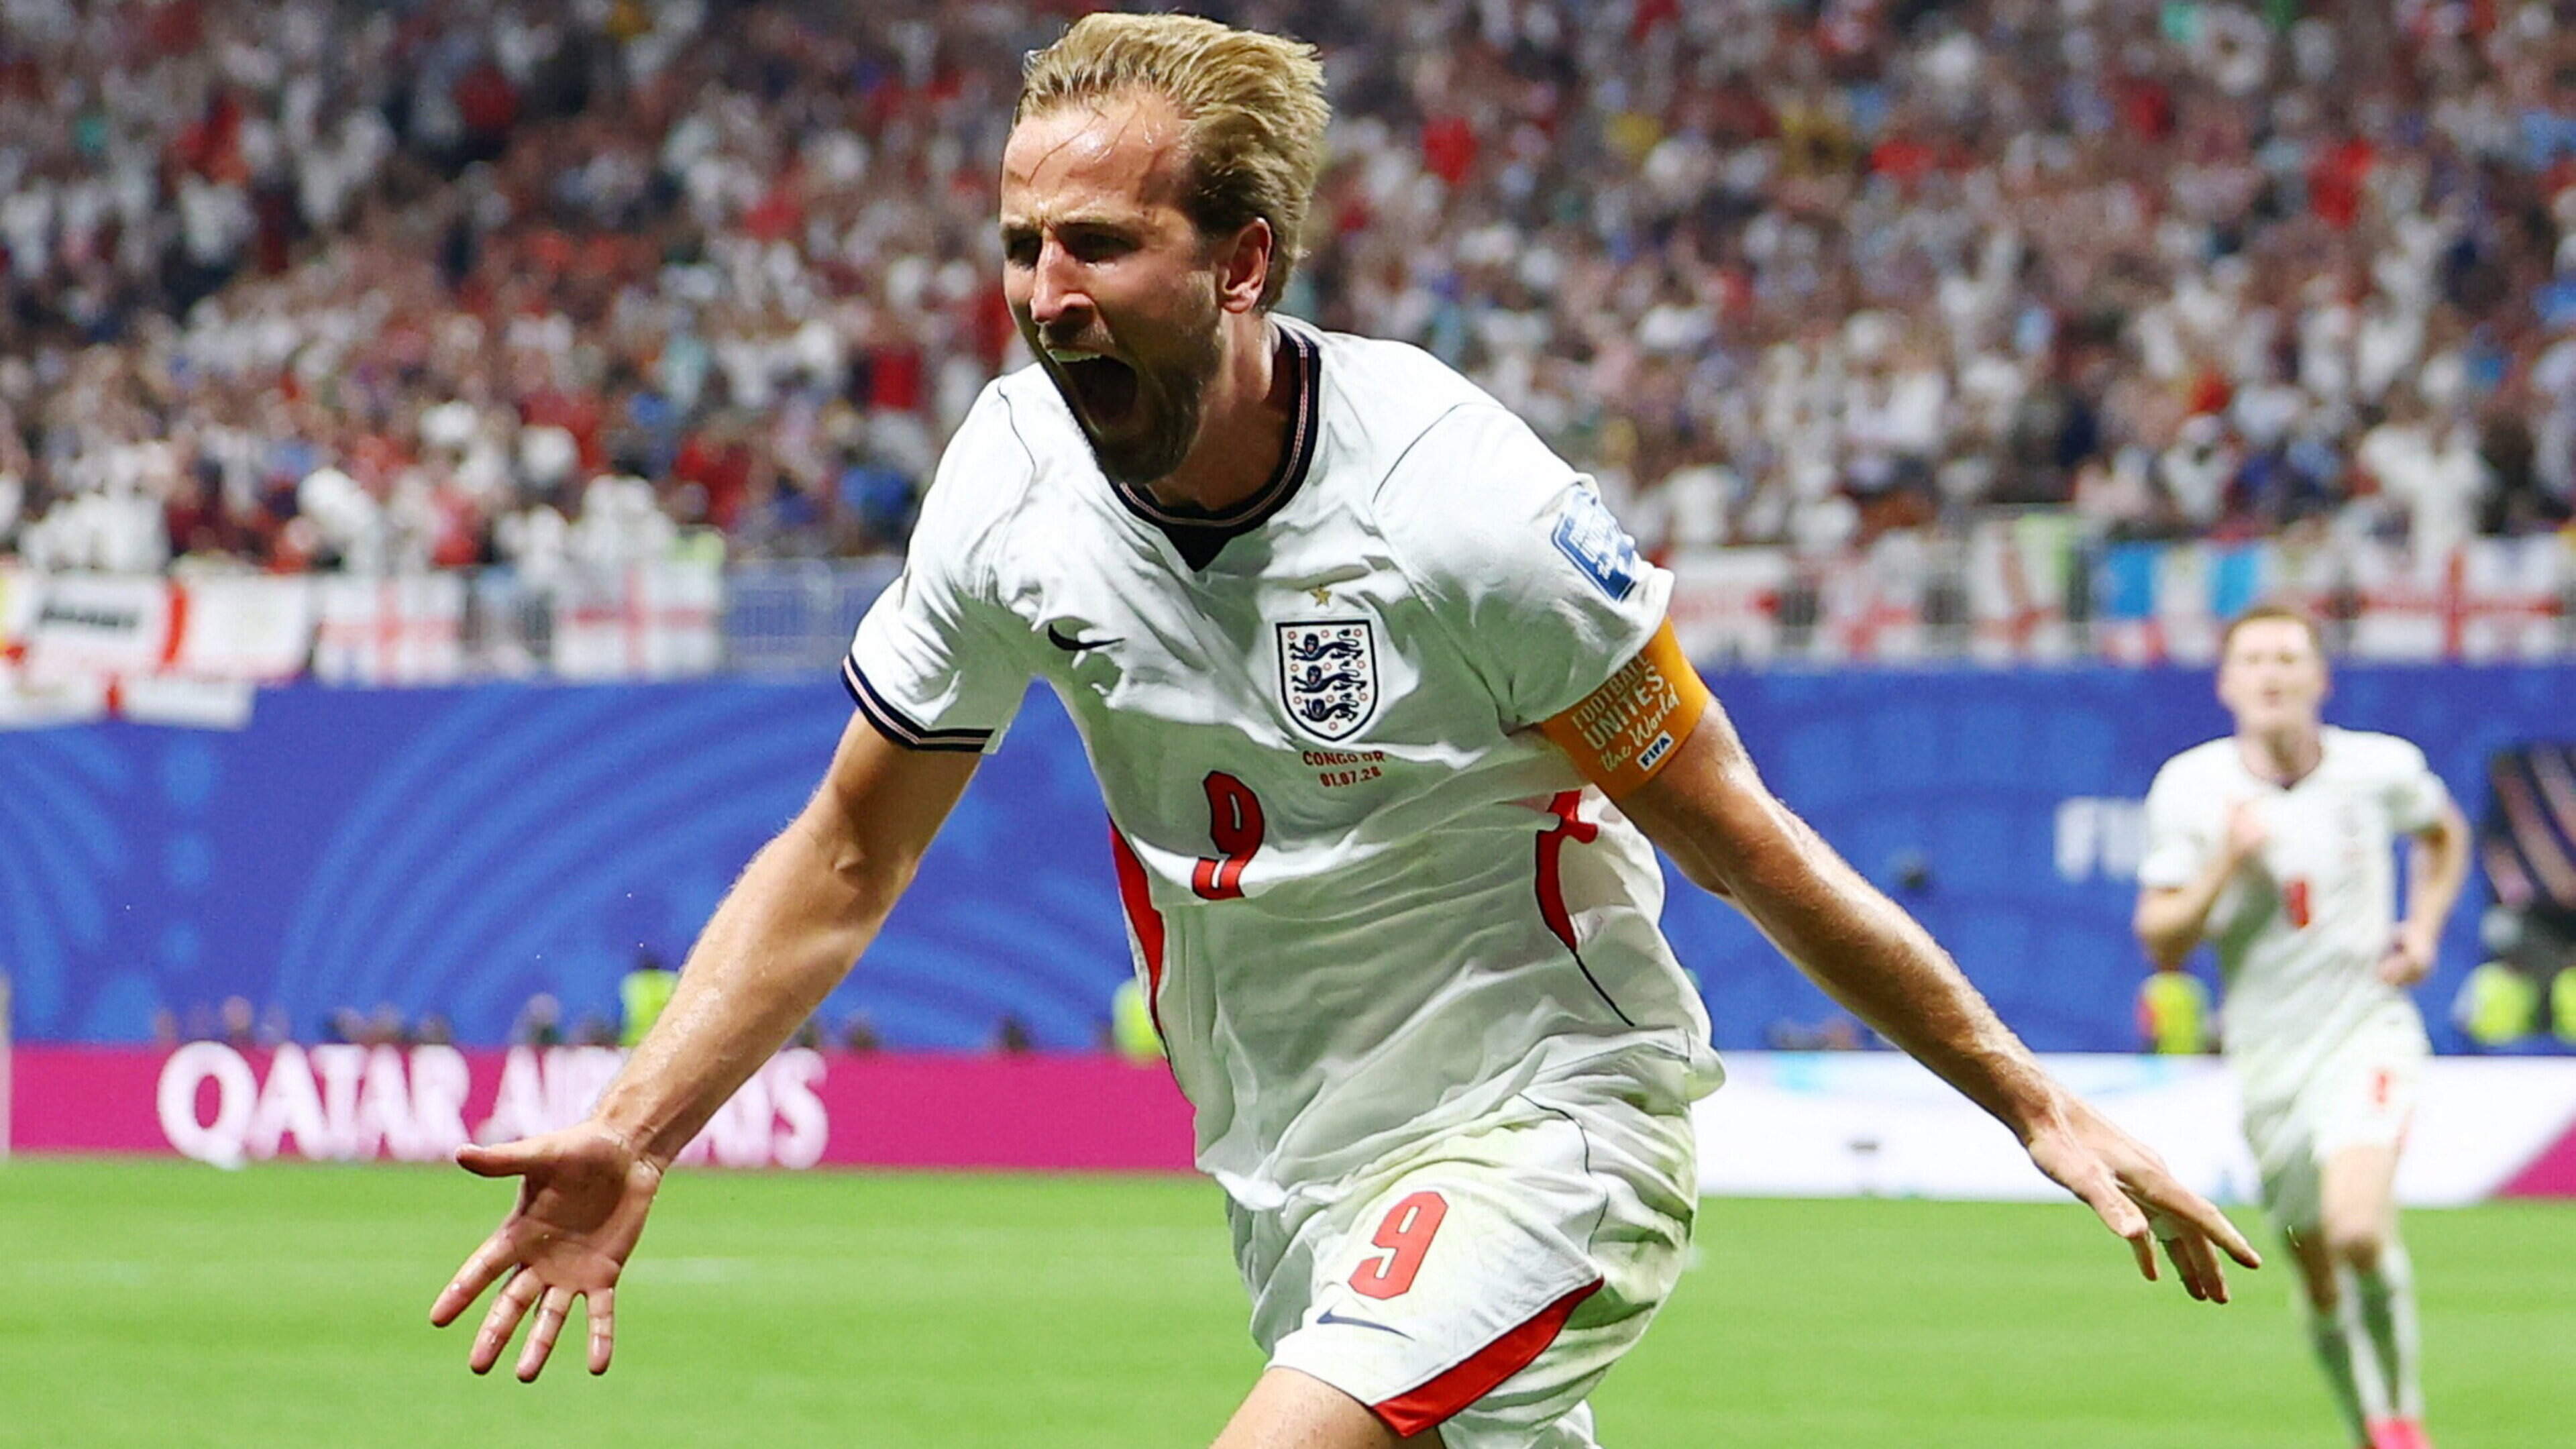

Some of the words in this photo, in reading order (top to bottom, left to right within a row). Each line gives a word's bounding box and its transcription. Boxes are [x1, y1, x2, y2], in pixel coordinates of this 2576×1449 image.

[1571, 653, 1650, 731] FOOTBALL
[1582, 665, 1664, 750] UNITES
[1599, 746, 1632, 772] the
[1627, 682, 1680, 747] World
[1303, 750, 1358, 765] CONGO
[1640, 737, 1671, 767] FIFA
[1191, 770, 1265, 900] 9
[155, 1040, 472, 1171] QATAR
[1348, 1191, 1448, 1301] 9
